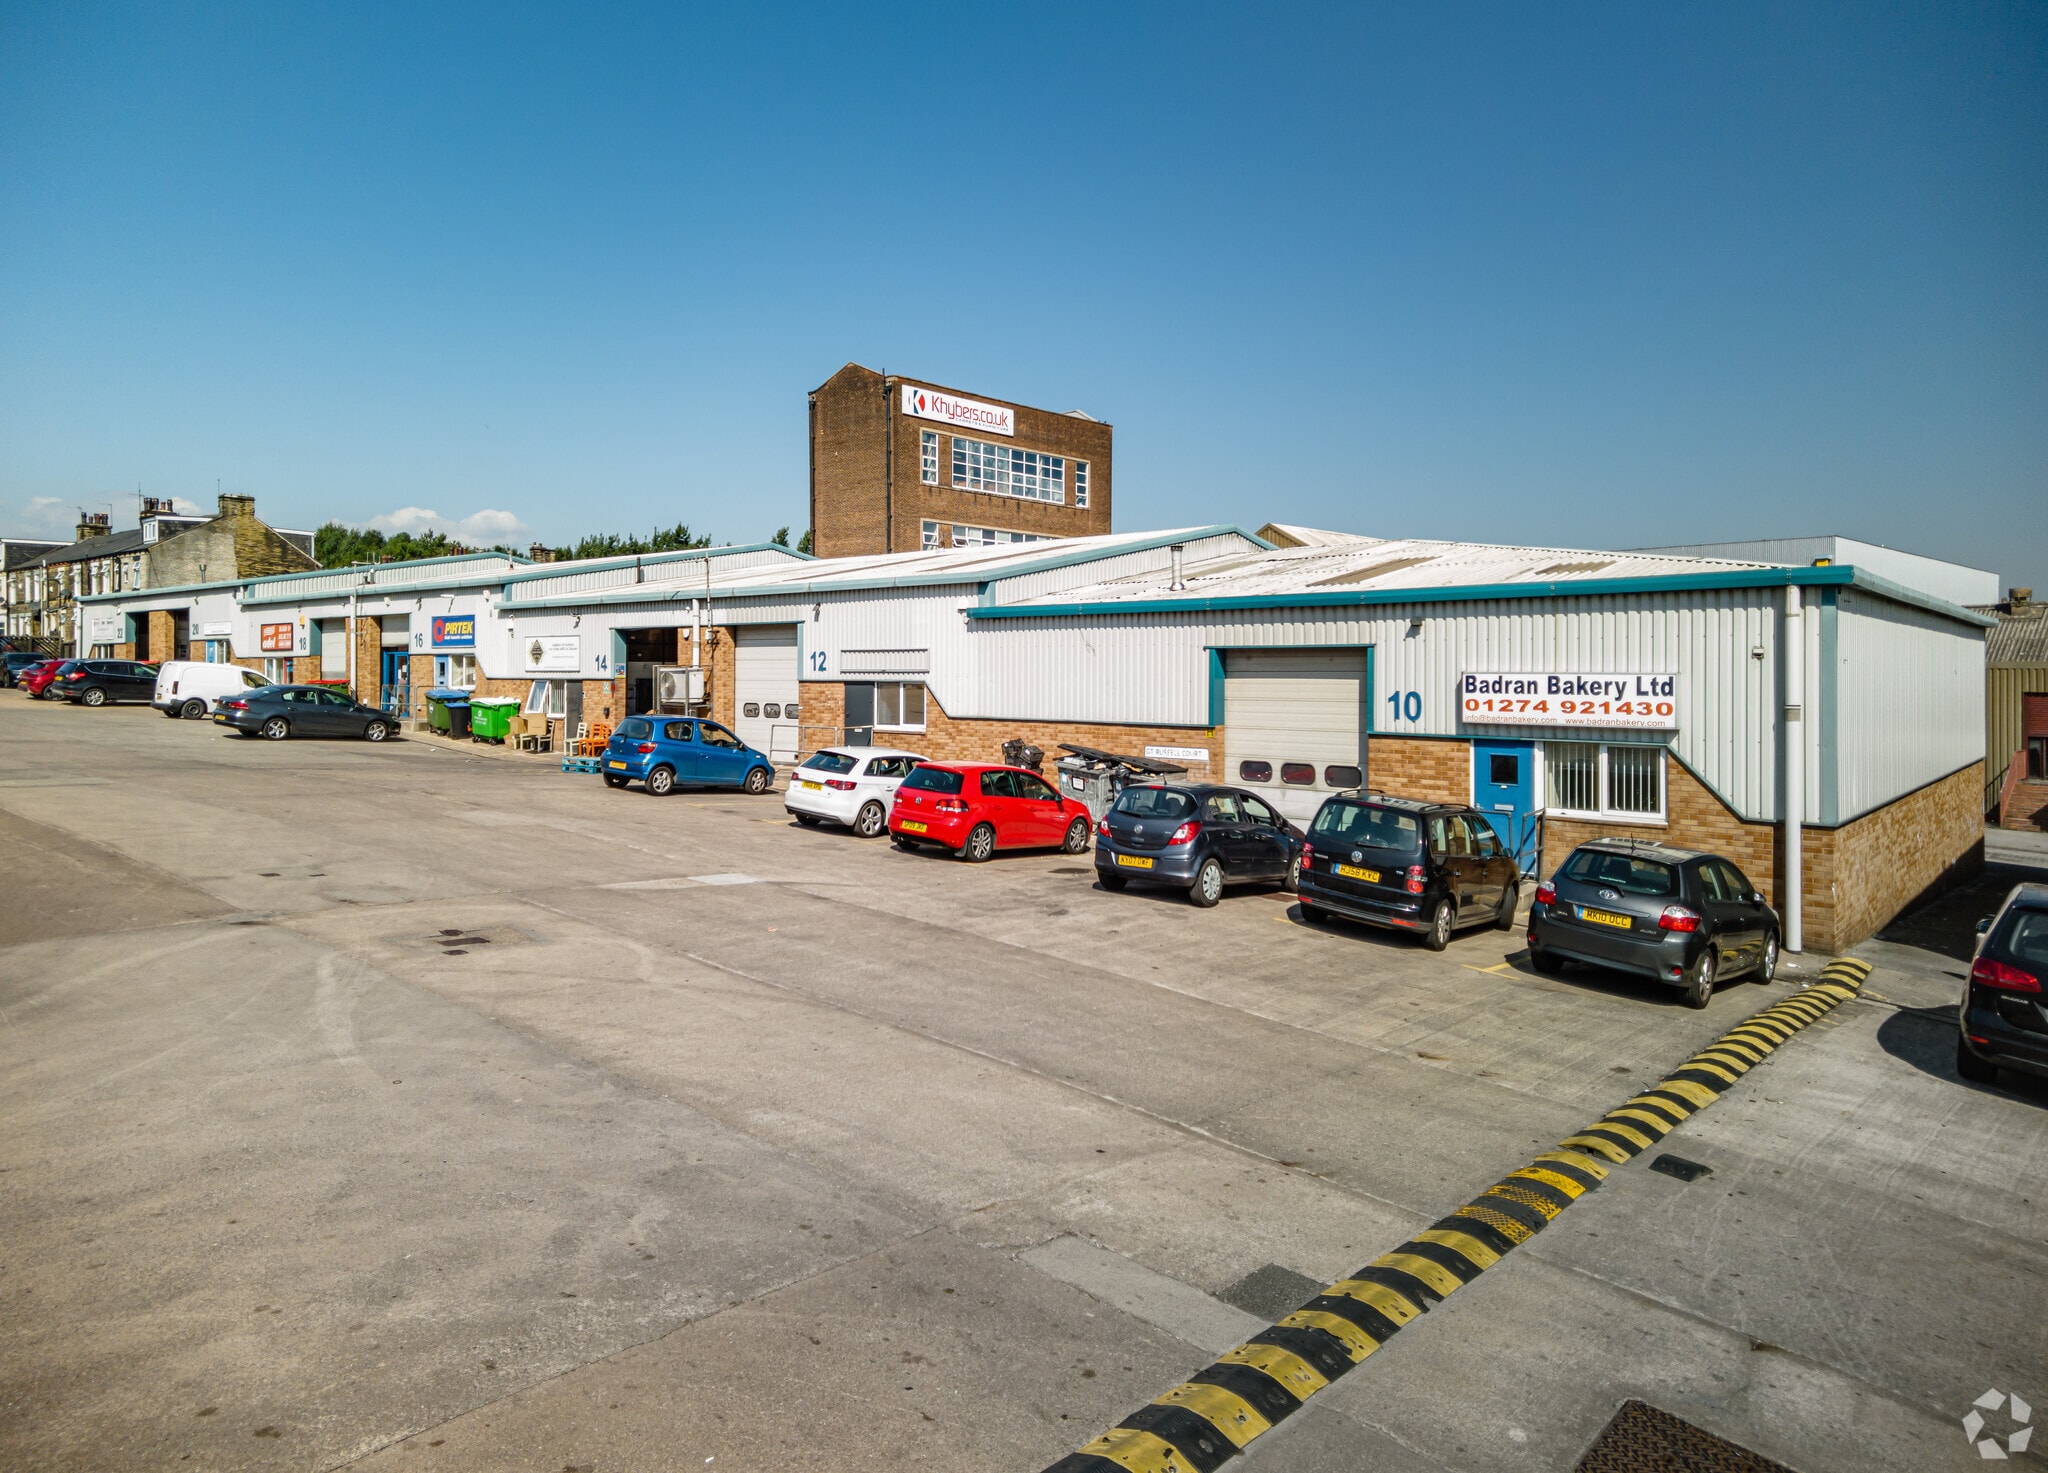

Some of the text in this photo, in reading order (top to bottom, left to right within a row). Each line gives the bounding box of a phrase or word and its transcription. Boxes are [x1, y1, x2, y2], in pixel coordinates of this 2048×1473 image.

[932, 395, 1008, 428] Khybers.co.uk
[192, 623, 199, 636] 20
[445, 621, 473, 635] PIRTEK
[299, 637, 307, 651] 18
[415, 633, 423, 648] 16
[595, 654, 608, 672] 14
[810, 650, 827, 672] 12
[1465, 675, 1674, 702] Badran Bakery Ltd
[1388, 690, 1422, 721] 10
[1465, 699, 1674, 717] 01274 921430
